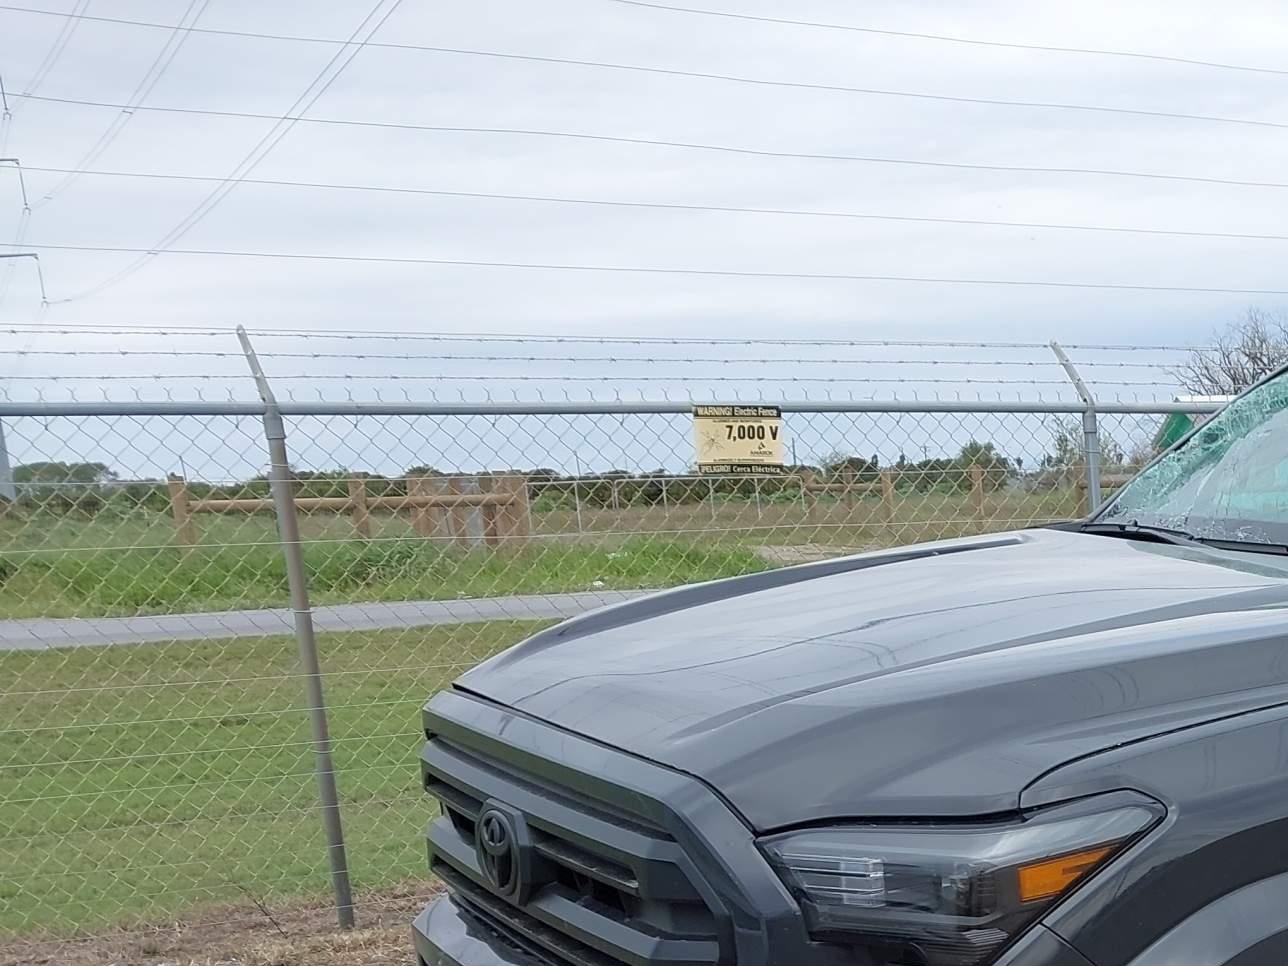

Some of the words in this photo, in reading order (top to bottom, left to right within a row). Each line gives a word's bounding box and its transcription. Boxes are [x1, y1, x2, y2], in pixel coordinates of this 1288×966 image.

[697, 406, 732, 416] WARNING!
[734, 407, 757, 416] Electric
[758, 407, 777, 416] Fence
[725, 425, 765, 442] 7,000
[769, 425, 779, 441] V
[733, 465, 750, 473] Cerca
